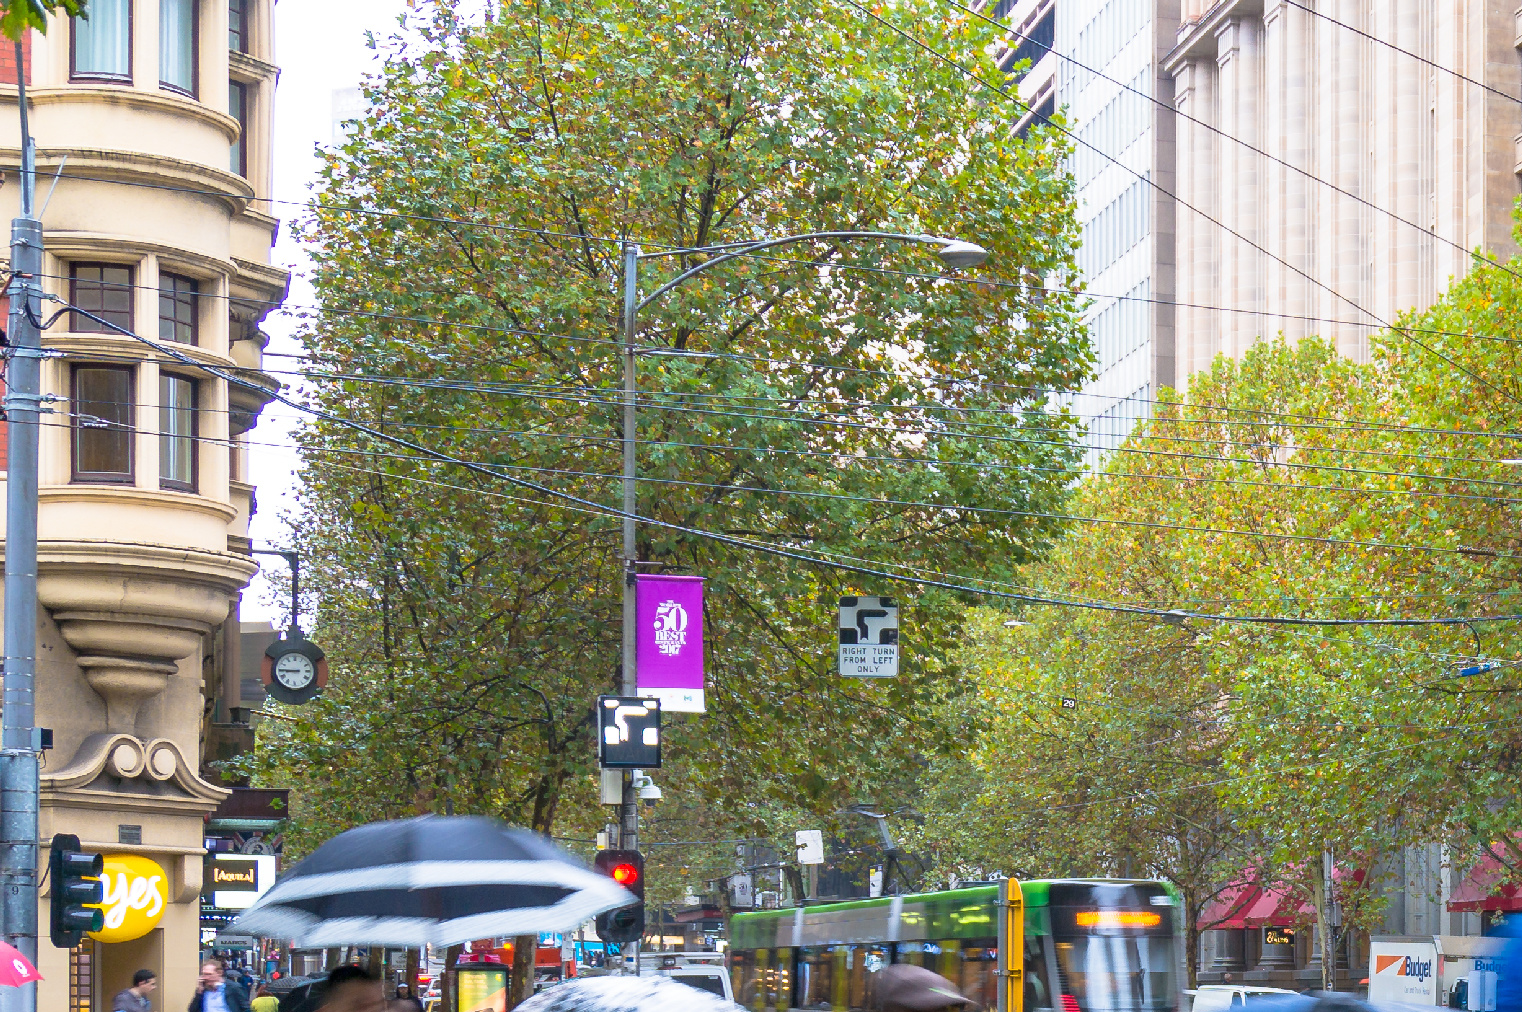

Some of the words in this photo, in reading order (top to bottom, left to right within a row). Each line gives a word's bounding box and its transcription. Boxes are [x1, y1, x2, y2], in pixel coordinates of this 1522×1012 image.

[653, 606, 688, 631] 50
[655, 631, 687, 641] BEST
[842, 647, 867, 655] RIGHT
[872, 647, 895, 655] TURN
[843, 656, 866, 664] FROM
[872, 656, 894, 664] LEFT
[857, 665, 880, 673] ONLY
[99, 872, 163, 930] yes
[1405, 956, 1431, 982] Budget
